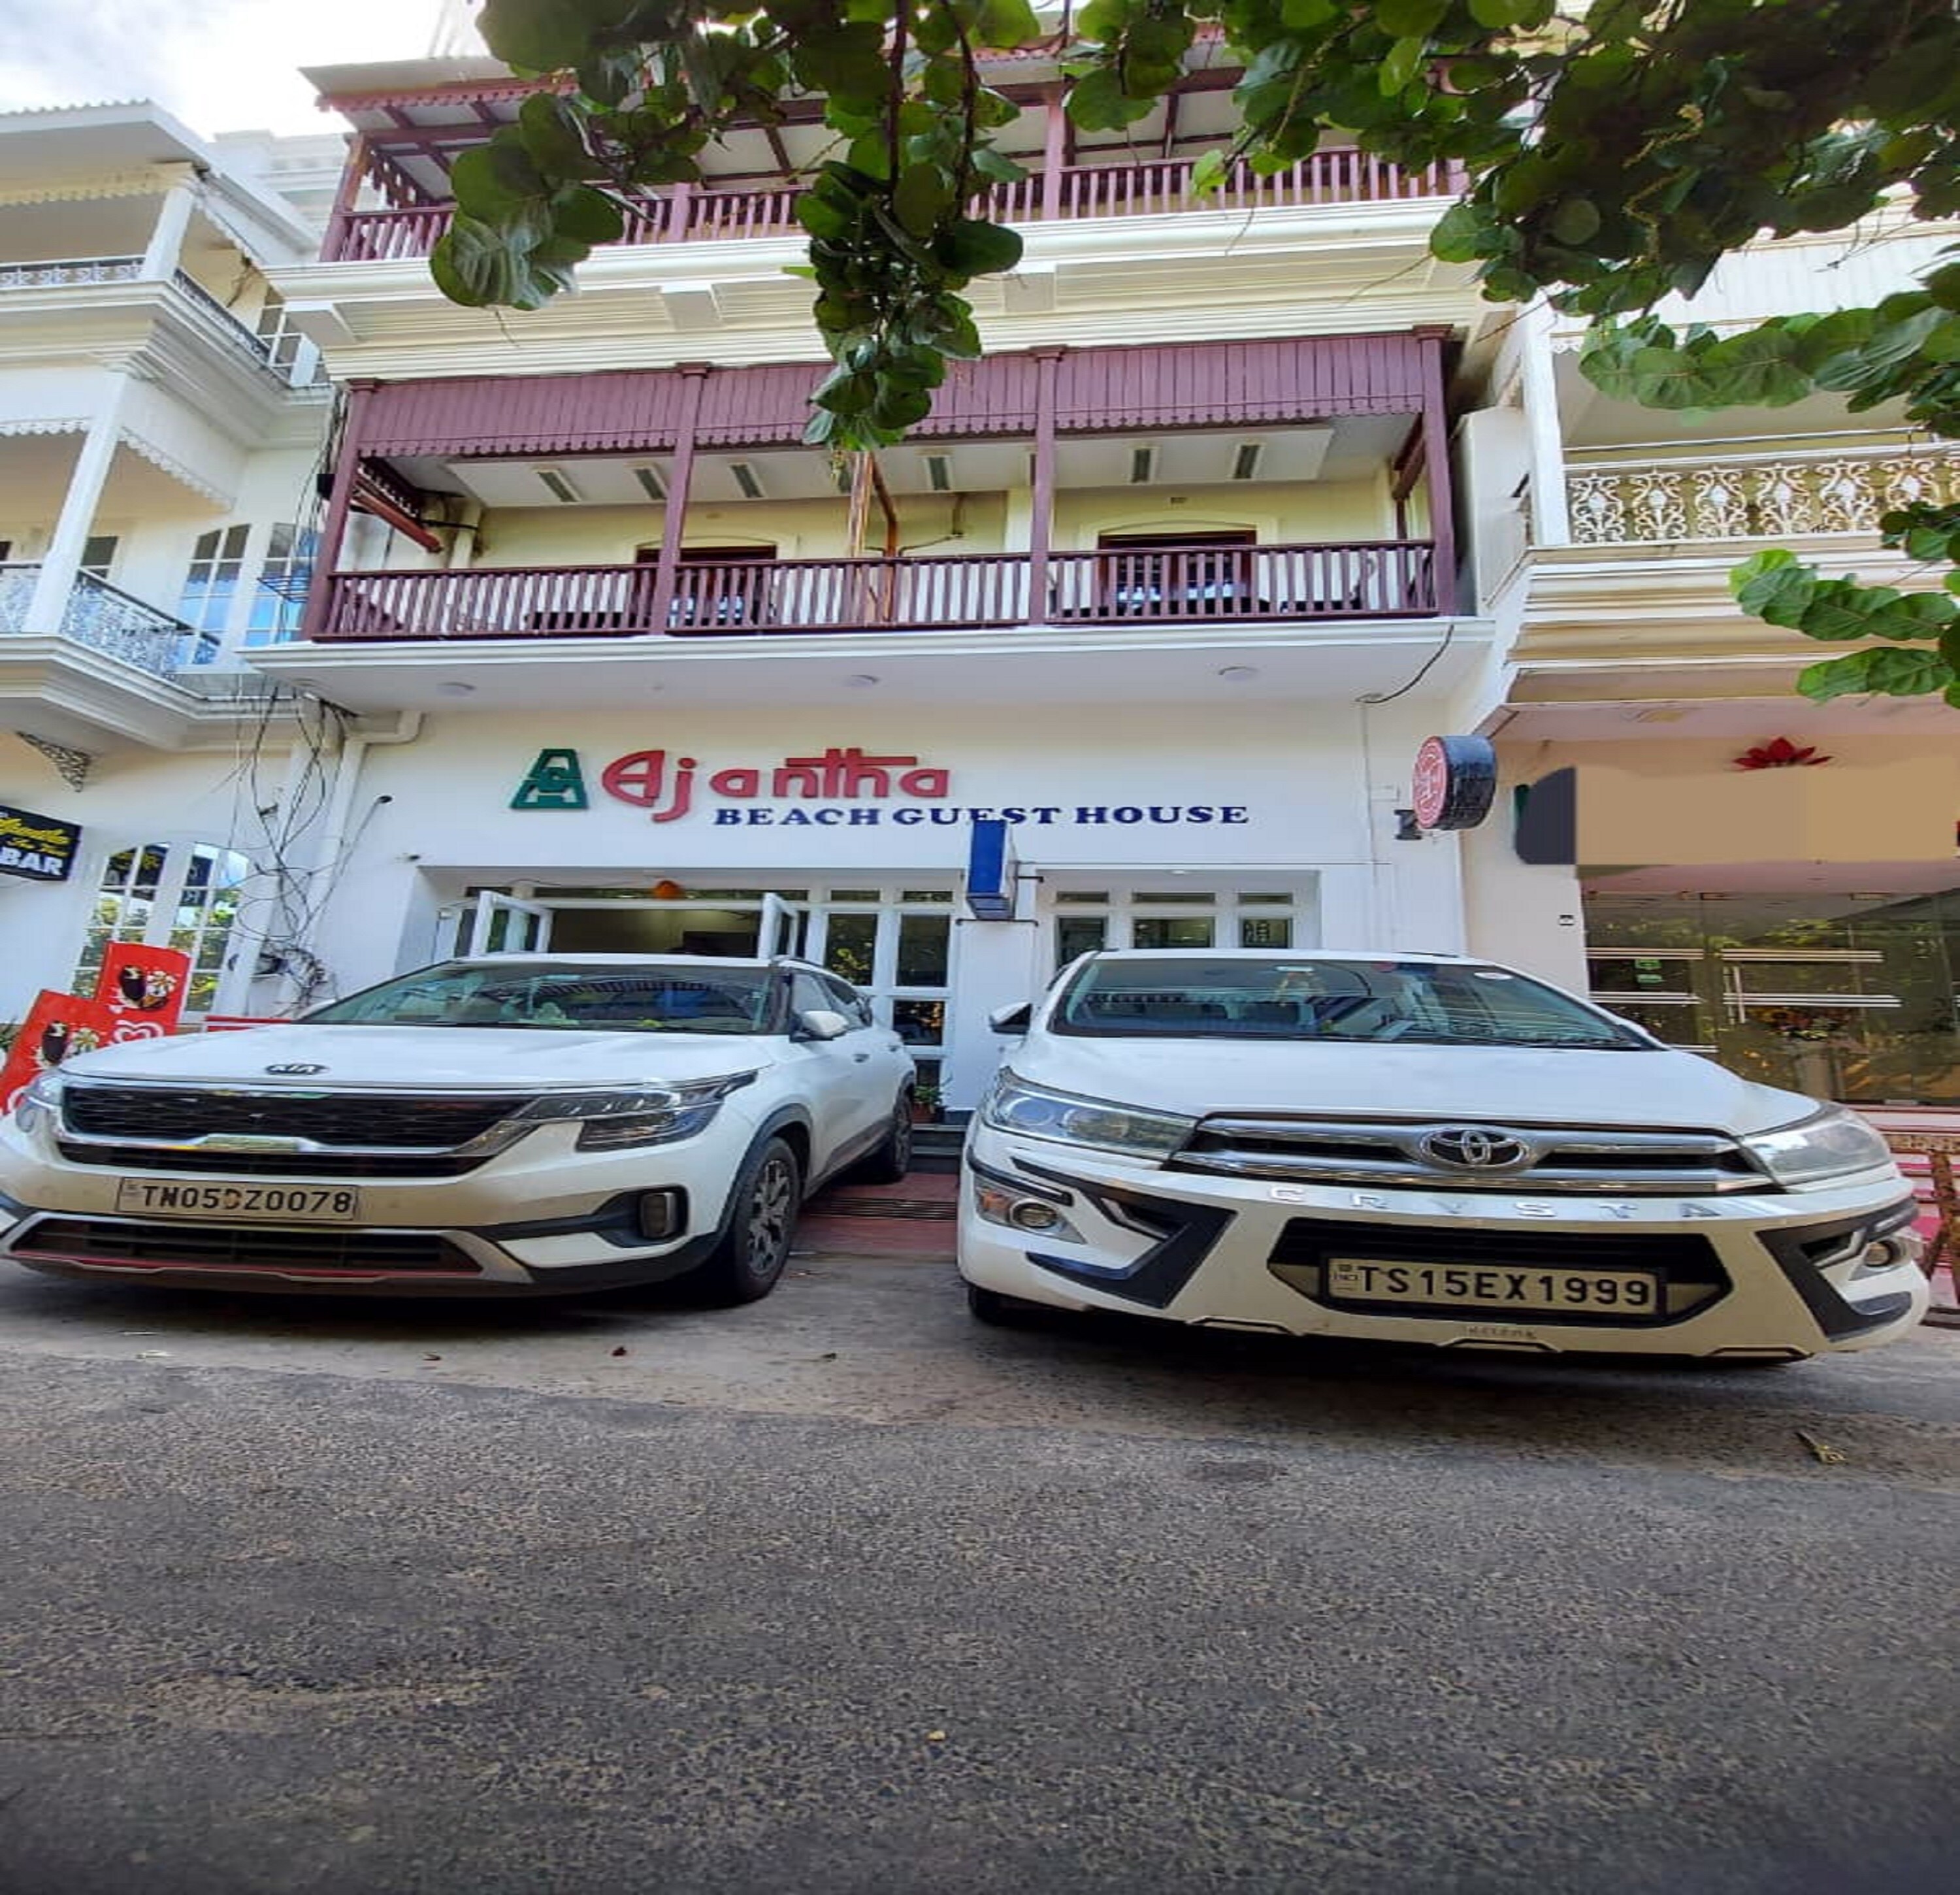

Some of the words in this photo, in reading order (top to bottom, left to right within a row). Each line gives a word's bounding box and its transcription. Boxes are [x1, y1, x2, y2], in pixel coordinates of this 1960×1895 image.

[601, 748, 949, 823] Ajantha
[714, 808, 879, 825] BEACH
[892, 808, 1061, 825] GUEST
[1075, 806, 1249, 824] HOUSE
[1357, 1265, 1650, 1306] TS15EX1999
